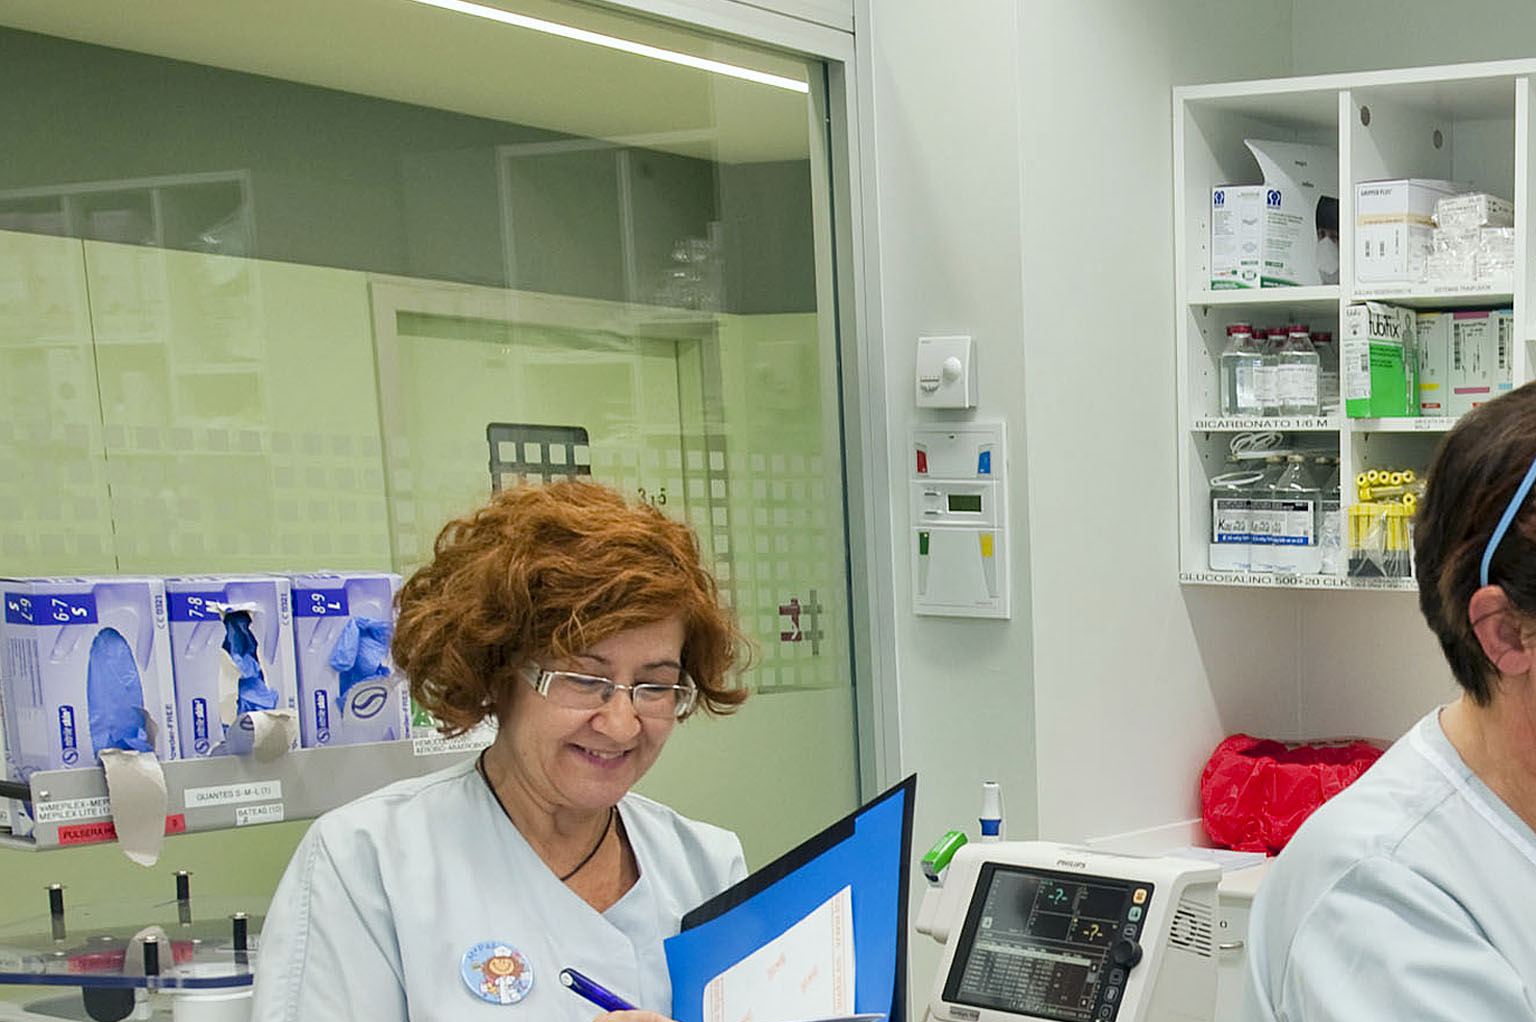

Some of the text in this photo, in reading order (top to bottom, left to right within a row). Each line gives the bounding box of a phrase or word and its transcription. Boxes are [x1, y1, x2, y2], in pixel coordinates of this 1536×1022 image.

[1195, 419, 1291, 428] BICARBONATO
[1316, 419, 1328, 427] M
[1178, 573, 1272, 585] GLUCOSALINO
[328, 601, 341, 611] L
[71, 606, 89, 618] S
[78, 807, 97, 818] LITE
[62, 827, 104, 840] PULSERA
[1056, 859, 1087, 869] PHILIPS
